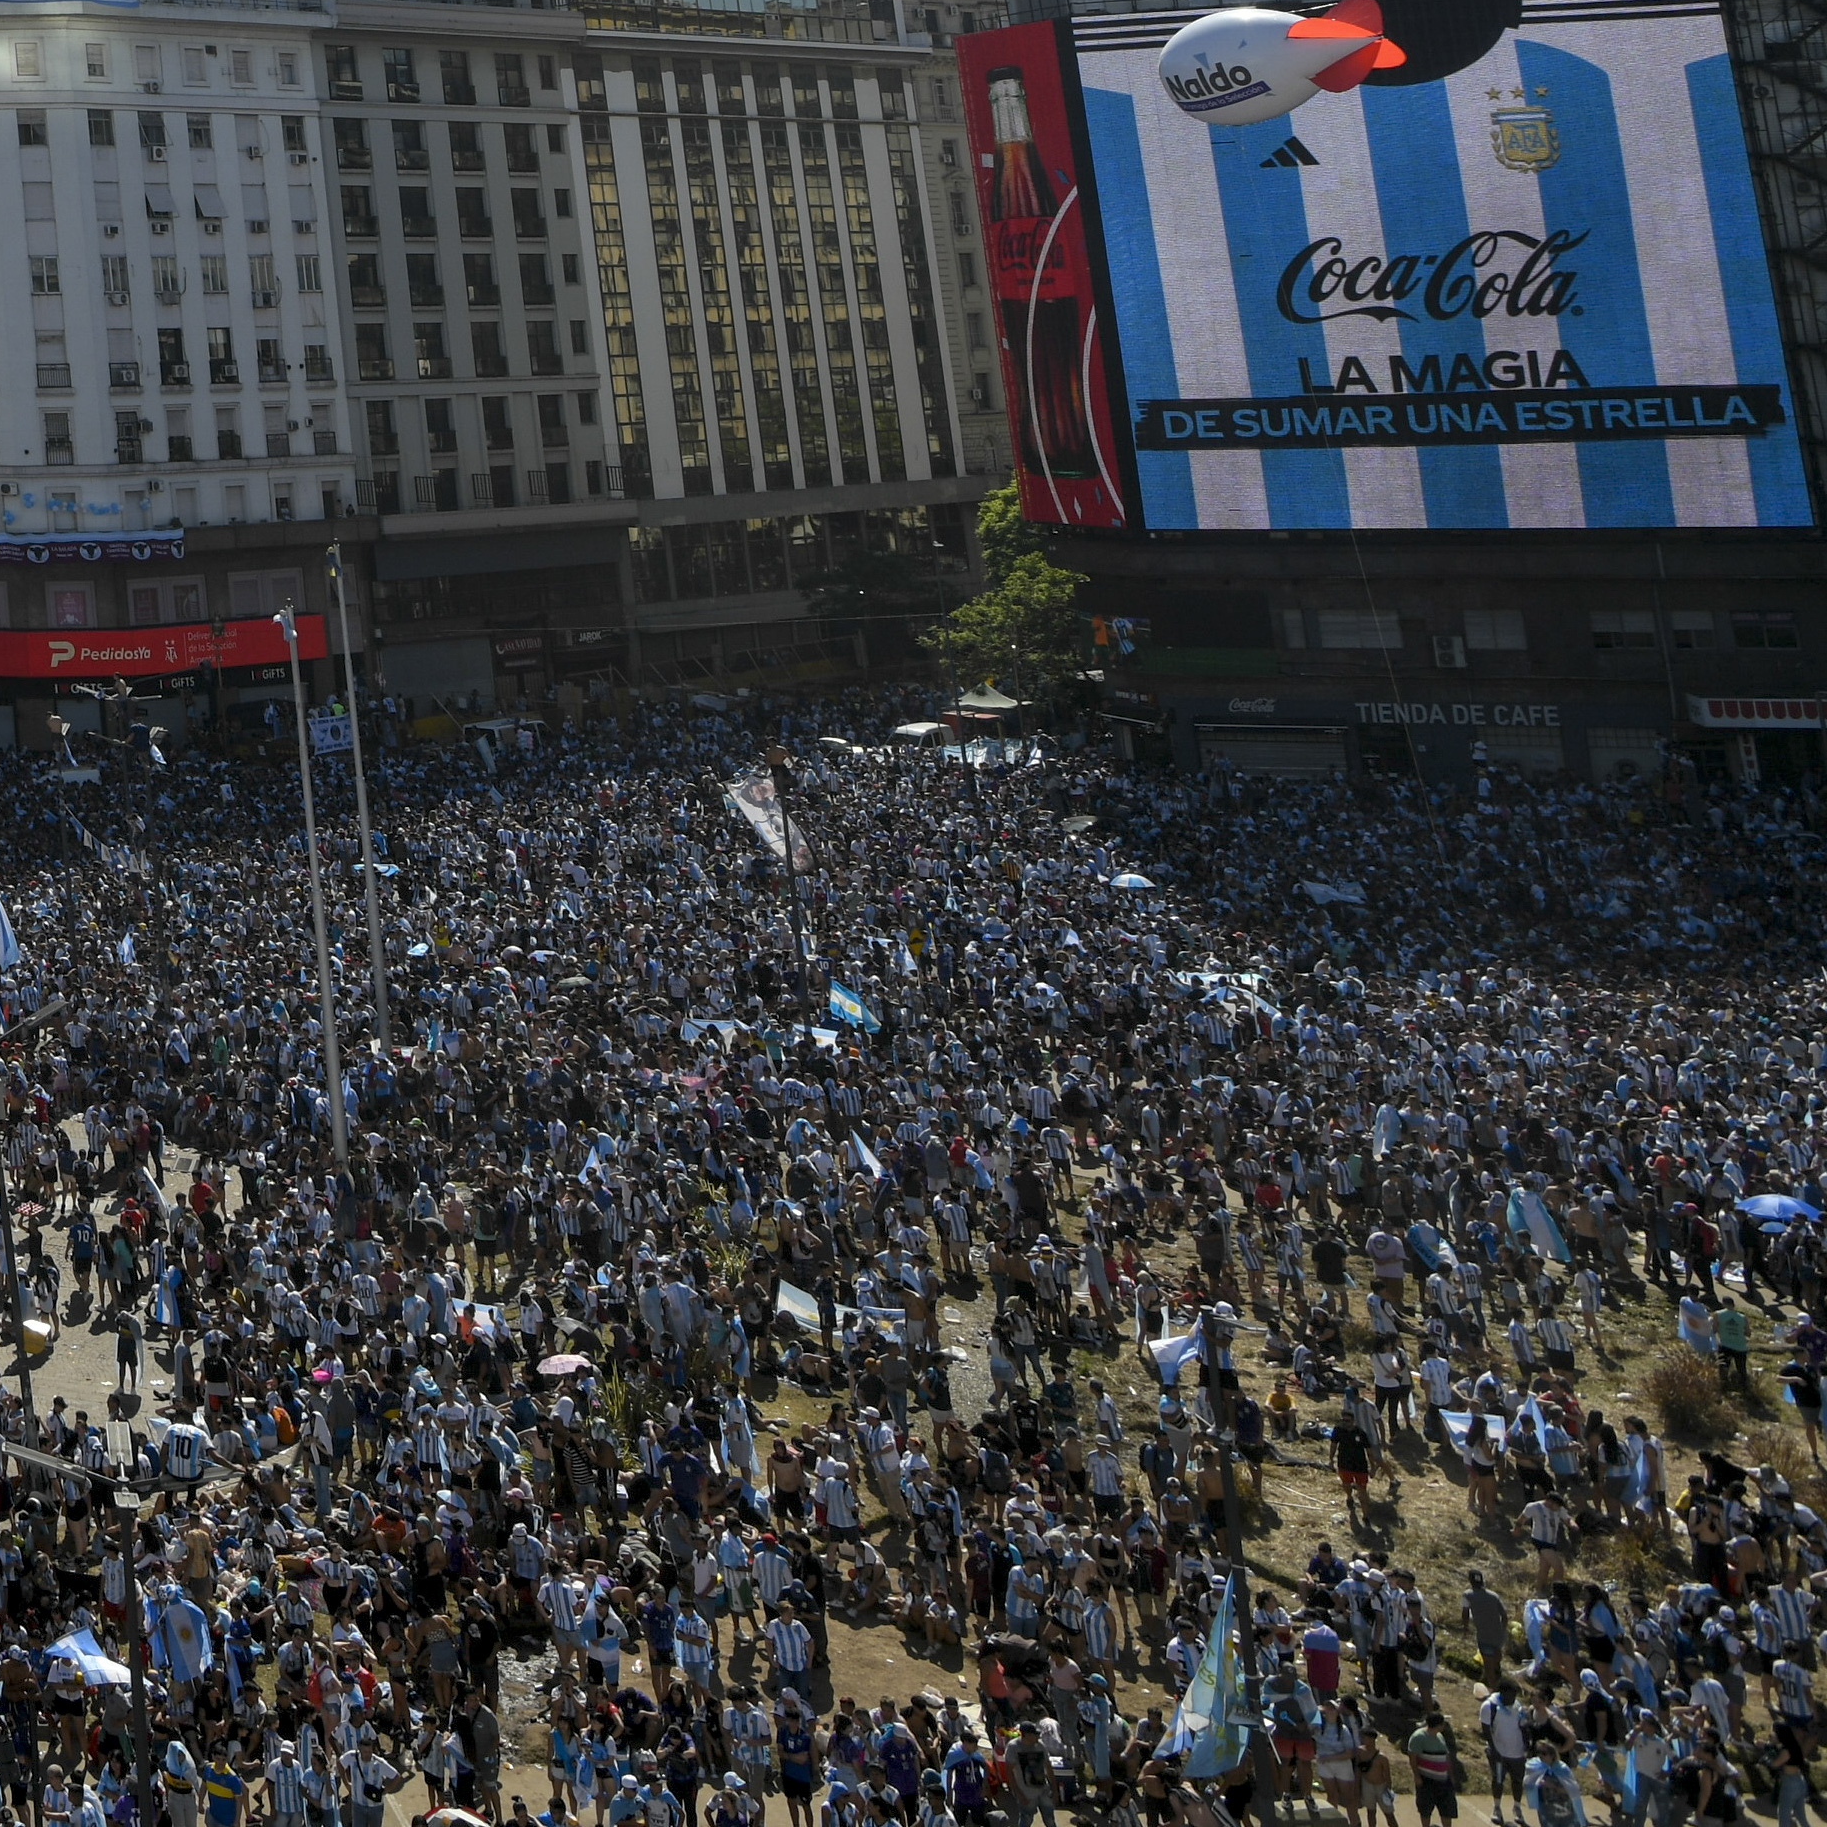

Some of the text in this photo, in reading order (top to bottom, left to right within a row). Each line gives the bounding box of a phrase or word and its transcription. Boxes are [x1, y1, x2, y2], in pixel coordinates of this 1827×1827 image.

[1165, 62, 1252, 100] Naldo
[1276, 229, 1590, 324] Coca-Cola
[1297, 349, 1591, 395] LA MAGIA
[1163, 396, 1757, 440] DE SUMAR UNA ESTRELLA
[81, 646, 150, 661] PedidosYa
[251, 670, 255, 680] I
[55, 684, 58, 694] I
[159, 679, 162, 689] I
[1229, 697, 1276, 713] Coca-Cola
[1354, 702, 1560, 727] TIENDA DE CAFE
[819, 961, 829, 970] 10
[788, 1087, 799, 1100] 10
[77, 1229, 89, 1243] 10
[1466, 1274, 1476, 1284] 10
[360, 1288, 370, 1299] 10
[175, 1435, 192, 1459] 10
